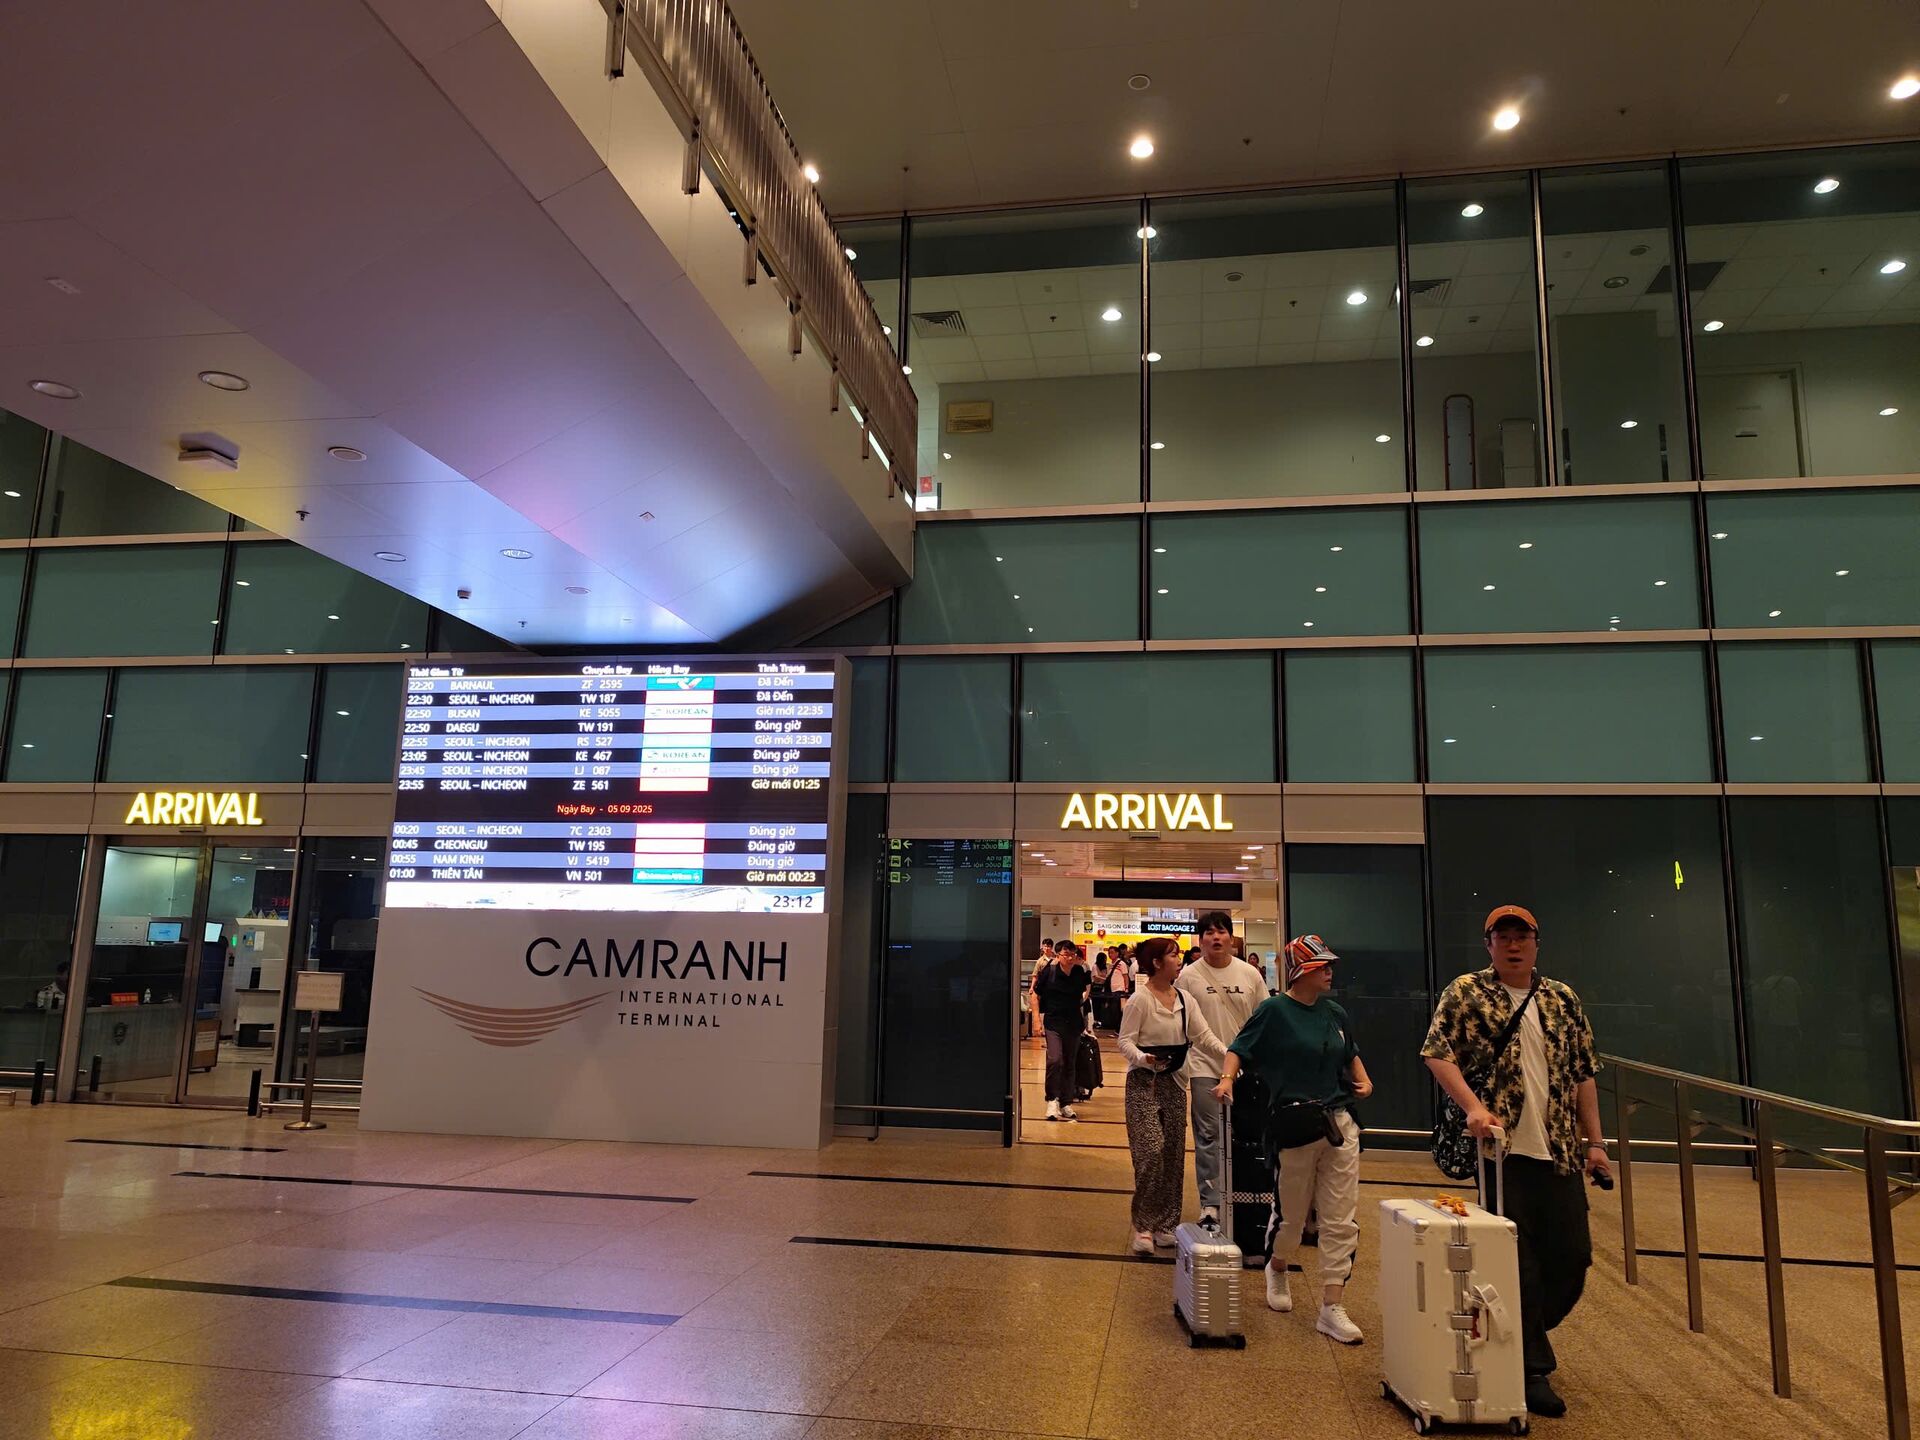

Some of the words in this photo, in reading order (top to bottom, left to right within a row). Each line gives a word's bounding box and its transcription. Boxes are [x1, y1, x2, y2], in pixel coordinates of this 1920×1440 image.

[410, 681, 434, 690] 22:20
[450, 681, 494, 690] BARNAUL
[582, 680, 593, 688] ZF
[600, 680, 622, 688] 2595
[758, 677, 771, 686] Đã
[408, 695, 433, 704] 22:30
[448, 695, 479, 704] SEOUL
[490, 694, 534, 704] INCHEON
[580, 694, 597, 703] TW
[599, 694, 616, 703] 187
[756, 691, 770, 701] Đã
[406, 709, 431, 719] 22:50
[448, 709, 480, 718] BUSAN
[580, 709, 591, 717] KE
[598, 708, 620, 717] 5055
[756, 706, 772, 715] Giờ
[776, 706, 794, 715] mới
[797, 706, 823, 715] 22:35
[405, 723, 430, 733] 22:50
[446, 723, 479, 733] DAEGU
[578, 723, 595, 732] TW
[597, 723, 613, 732] 191
[755, 720, 782, 732] Đúng
[784, 720, 802, 732] giờ
[404, 737, 427, 746] 22:55
[444, 737, 474, 746] SEOUL
[485, 737, 530, 746] INCHEON
[577, 737, 589, 746] RS
[595, 737, 613, 746] 527
[755, 735, 772, 744] Giờ
[774, 735, 792, 744] mới
[796, 736, 822, 744] 23:30
[402, 752, 427, 761] 23:05
[443, 752, 474, 761] SEOUL
[484, 751, 529, 761] INCHEON
[576, 752, 588, 761] KE
[593, 751, 612, 761] 467
[753, 749, 780, 761] Đúng
[783, 749, 800, 761] giờ
[400, 766, 424, 775] 23:45
[442, 766, 473, 775] SEOUL
[482, 765, 527, 775] INCHEON
[593, 766, 610, 775] 087
[752, 764, 779, 776] Đúng
[782, 764, 799, 776] giờ
[399, 781, 424, 790] 23:55
[440, 780, 471, 790] SEOUL
[481, 780, 526, 790] INCHEON
[572, 781, 586, 790] ZE
[591, 781, 608, 790] 561
[752, 779, 770, 789] Giờ
[772, 779, 790, 789] mới
[793, 780, 820, 789] 01:25
[125, 792, 263, 826] ARRIVAL
[558, 804, 578, 814] Ngày
[580, 805, 595, 815] Bay
[608, 805, 619, 813] 05
[620, 805, 630, 813] 09
[632, 805, 652, 813] 2025
[1060, 792, 1233, 831] ARRIVAL
[394, 826, 419, 834] 00:20
[436, 826, 467, 835] SEOUL
[477, 826, 522, 835] INCHEON
[570, 826, 582, 835] 7C
[588, 826, 611, 836] 2303
[749, 826, 776, 838] Đúng
[779, 826, 796, 838] giờ
[393, 840, 418, 849] 00:45
[434, 840, 488, 850] CHEONGJU
[568, 841, 585, 851] TW
[588, 841, 605, 851] 195
[748, 841, 776, 854] Đúng
[778, 841, 795, 854] giờ
[392, 854, 416, 863] 00:55
[433, 855, 457, 864] NAM
[460, 855, 484, 864] KINH
[568, 856, 578, 865] VJ
[586, 856, 610, 866] 5419
[748, 856, 774, 868] Đúng
[778, 856, 794, 868] giờ
[390, 869, 415, 878] 01:00
[432, 868, 460, 879] THIÊN
[463, 868, 483, 879] TÂN
[566, 871, 581, 881] VN
[584, 871, 602, 881] 501
[746, 871, 765, 881] Giờ
[767, 871, 786, 882] mới
[789, 872, 816, 882] 00:23
[773, 896, 813, 908] 23:12
[1162, 924, 1190, 932] BAGGAGE
[526, 936, 788, 982] CAMRANH
[620, 990, 784, 1007] INTERNATIONAL
[618, 1012, 721, 1028] TERMINAL
